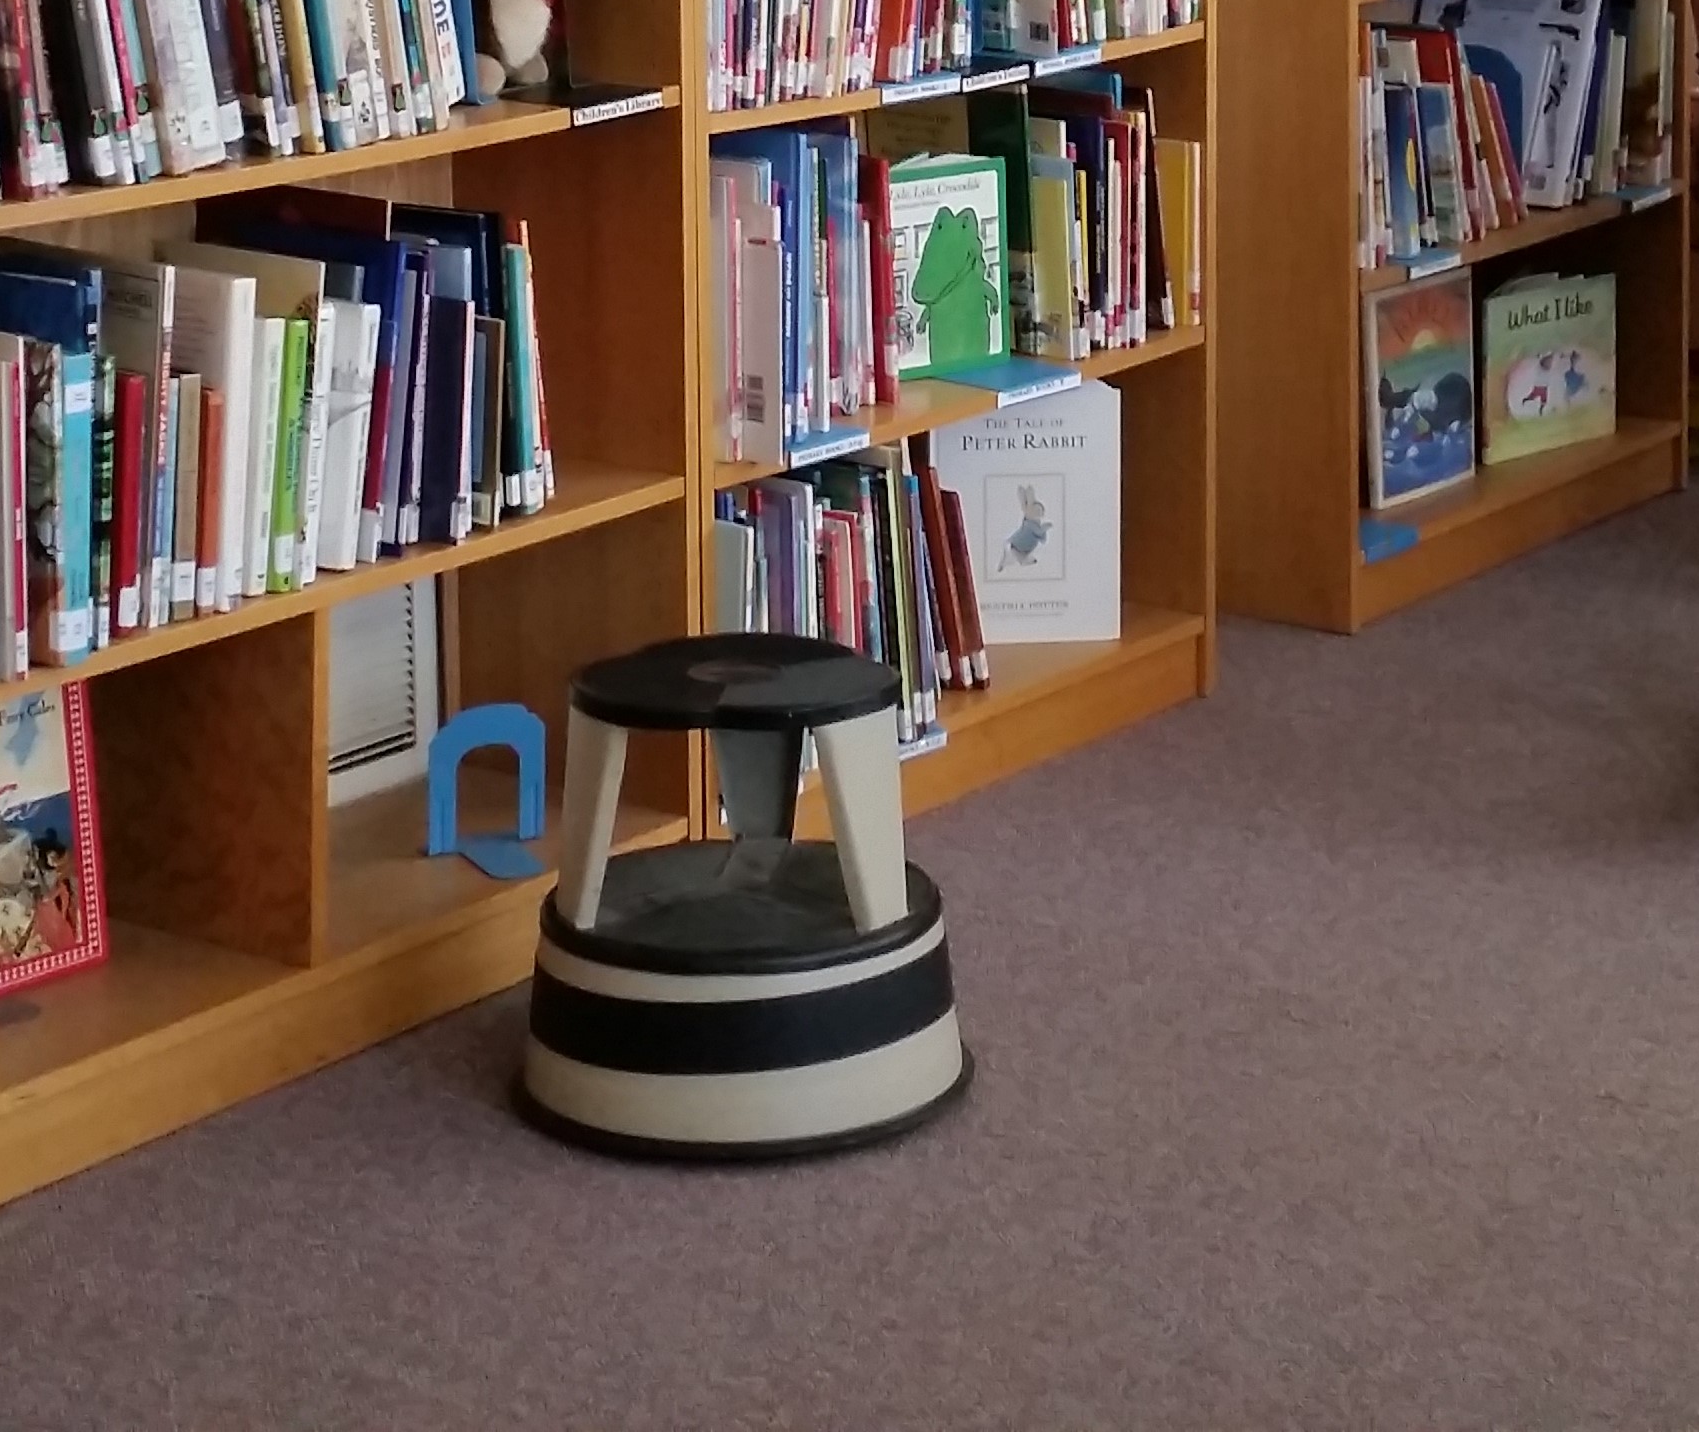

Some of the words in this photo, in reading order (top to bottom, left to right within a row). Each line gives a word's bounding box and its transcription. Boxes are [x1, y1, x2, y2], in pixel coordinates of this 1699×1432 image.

[1507, 304, 1550, 331] What
[1555, 298, 1562, 321] I
[1564, 292, 1593, 317] like
[985, 418, 1008, 430] THE
[1016, 417, 1044, 429] TALE
[1053, 418, 1064, 428] OF
[962, 435, 1016, 451] PETER
[1023, 434, 1088, 449] RABBIT
